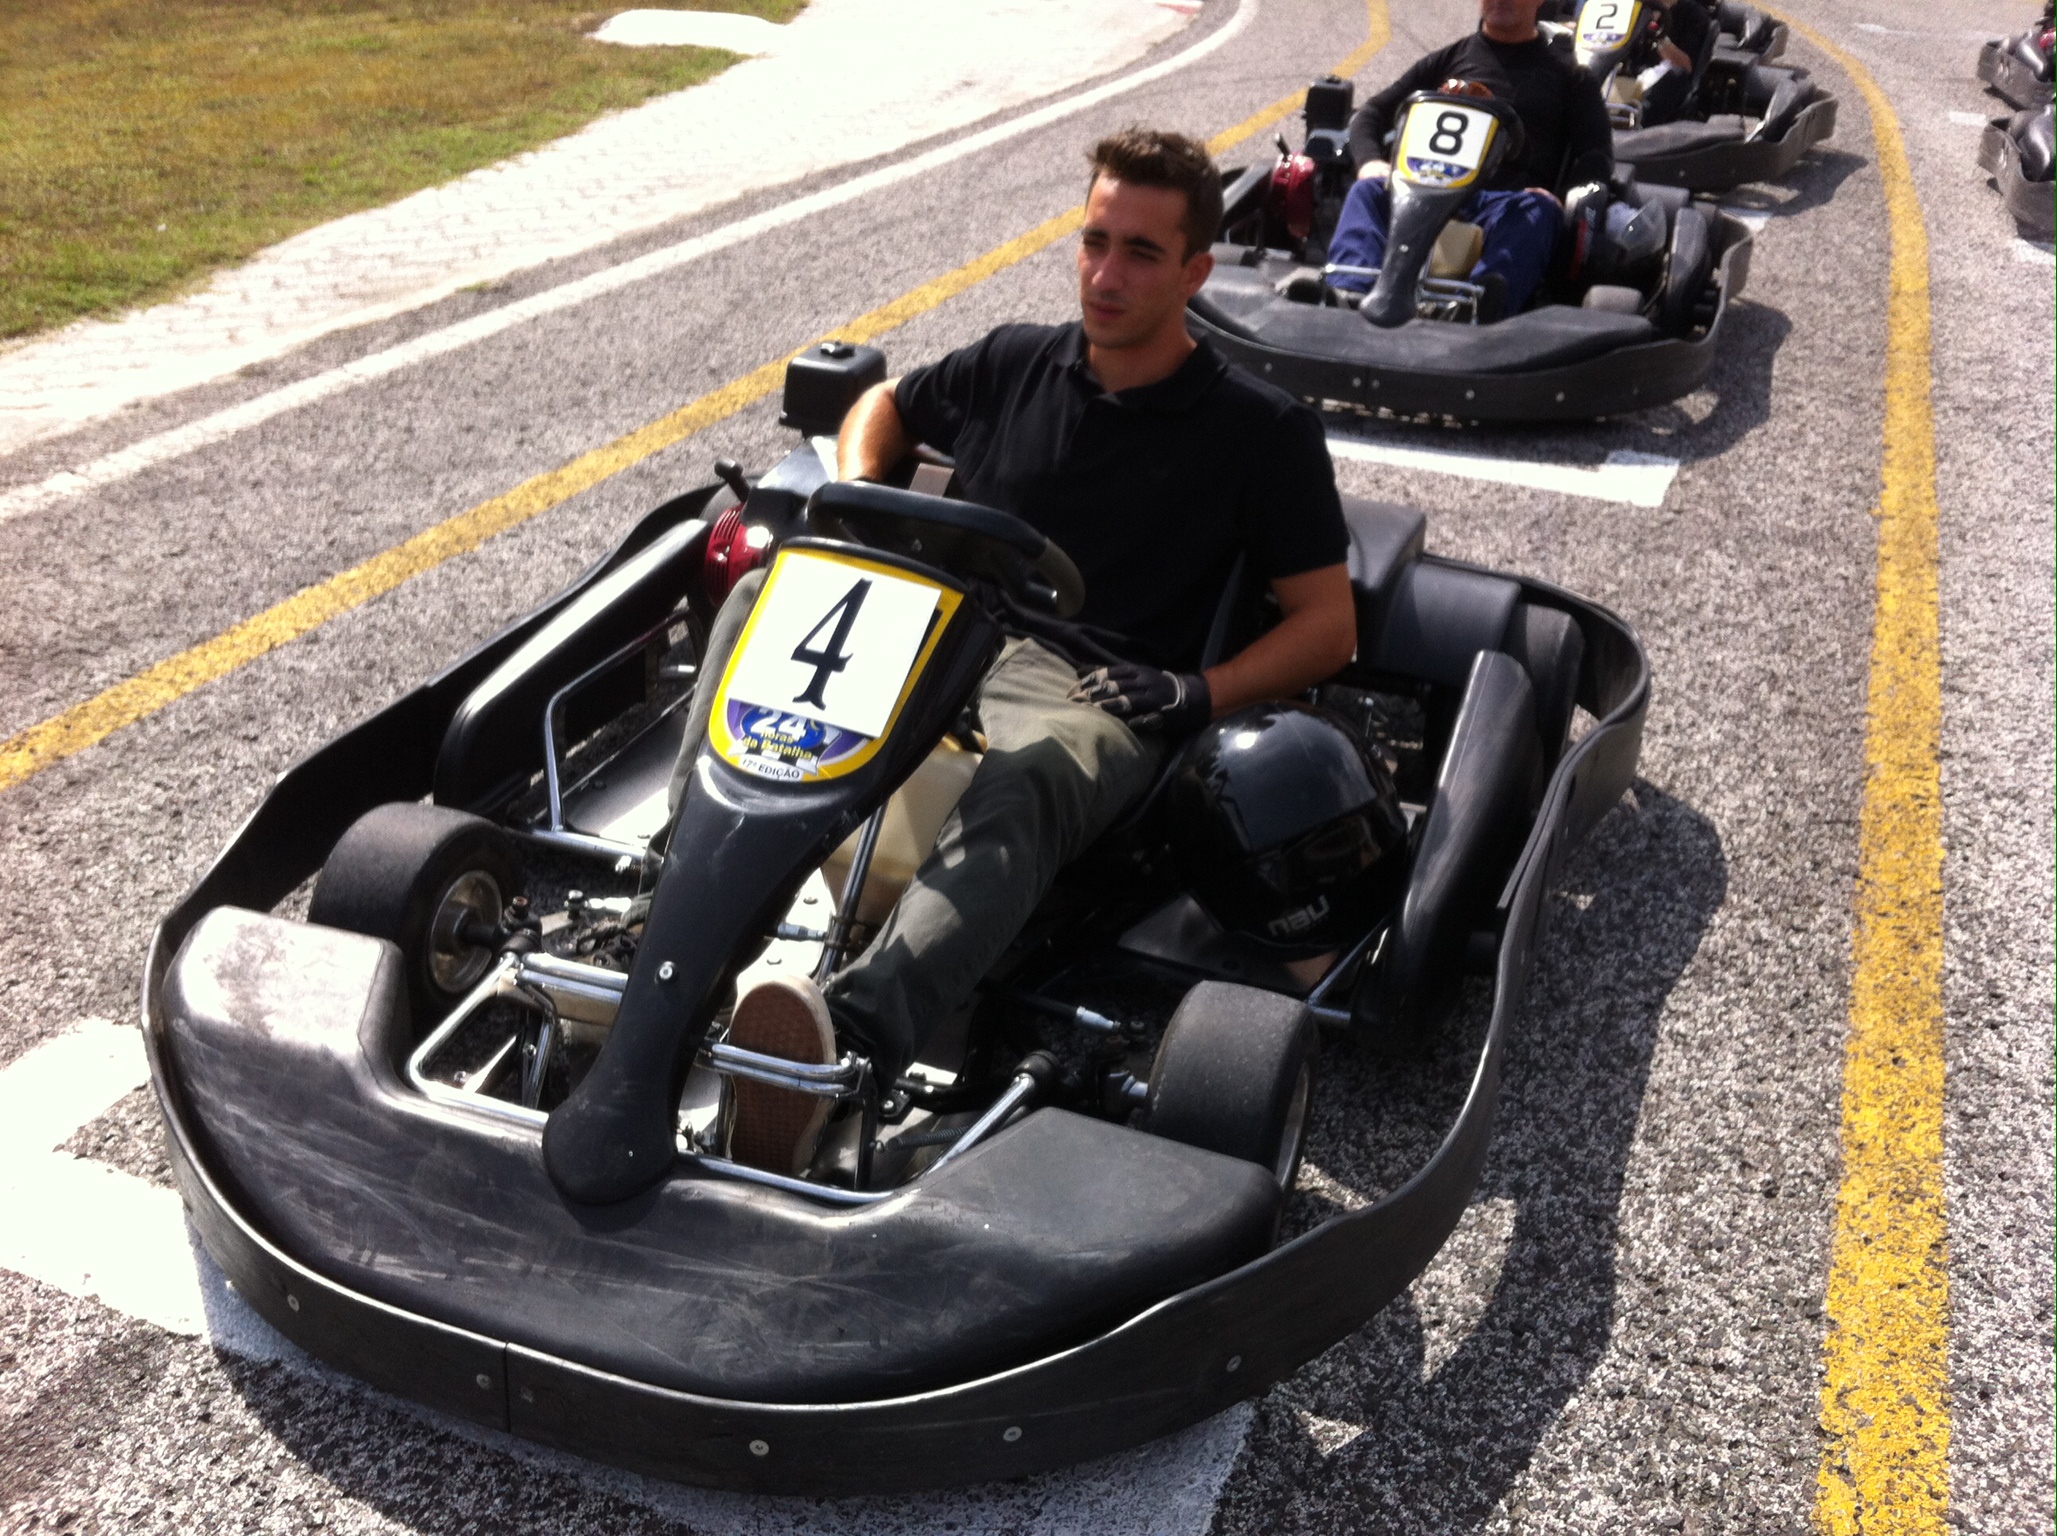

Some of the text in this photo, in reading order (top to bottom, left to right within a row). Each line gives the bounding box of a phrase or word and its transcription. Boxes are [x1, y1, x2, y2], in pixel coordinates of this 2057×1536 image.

[1595, 3, 1618, 30] 2
[1429, 111, 1469, 156] 8
[790, 577, 873, 711] 4
[750, 707, 808, 741] 24
[743, 736, 758, 749] da
[758, 763, 801, 781] EDIÇÃO
